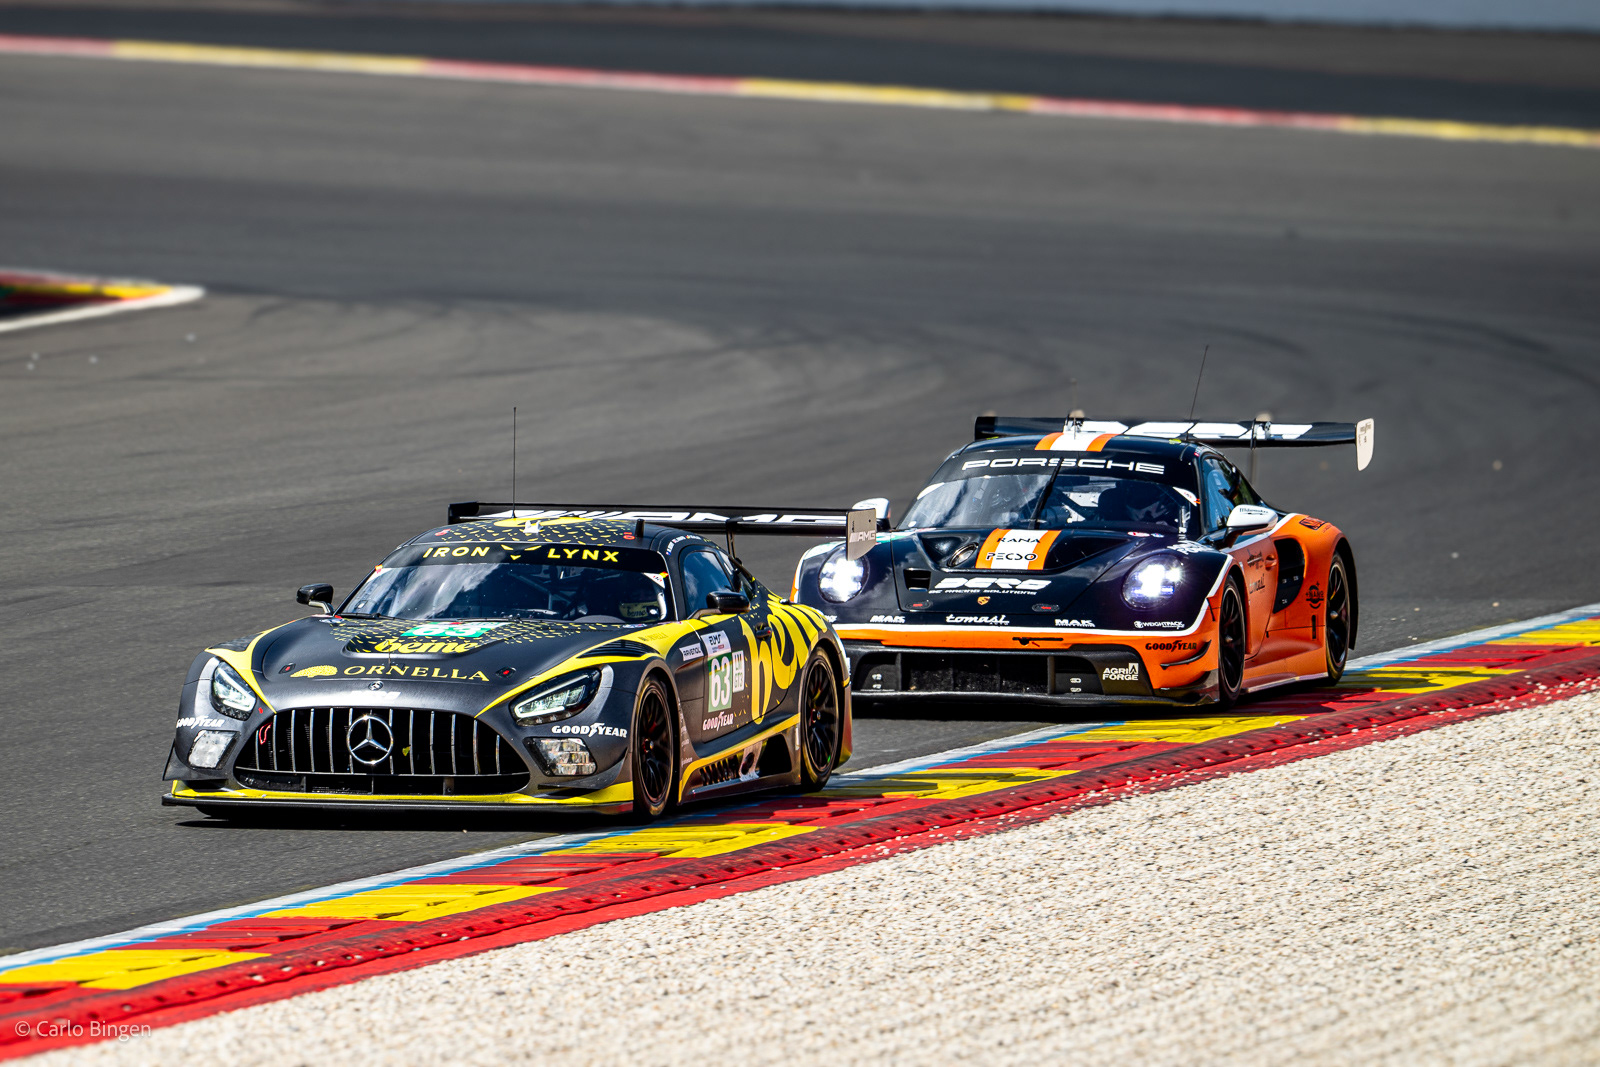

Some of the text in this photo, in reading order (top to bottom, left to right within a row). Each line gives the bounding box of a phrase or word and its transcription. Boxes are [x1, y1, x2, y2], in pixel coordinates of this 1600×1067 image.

[961, 457, 1165, 474] PORSCHE
[423, 546, 620, 562] IRON LYNX
[945, 613, 1009, 624] tomasi
[412, 624, 478, 637] 63
[374, 637, 480, 653] beme
[1145, 640, 1197, 652] GOODYEAR
[343, 665, 490, 682] ORNELLA
[1102, 673, 1139, 681] FORGE
[711, 656, 731, 708] 63
[703, 711, 734, 731] GOODYEAR
[551, 722, 628, 738] GOODYEAR
